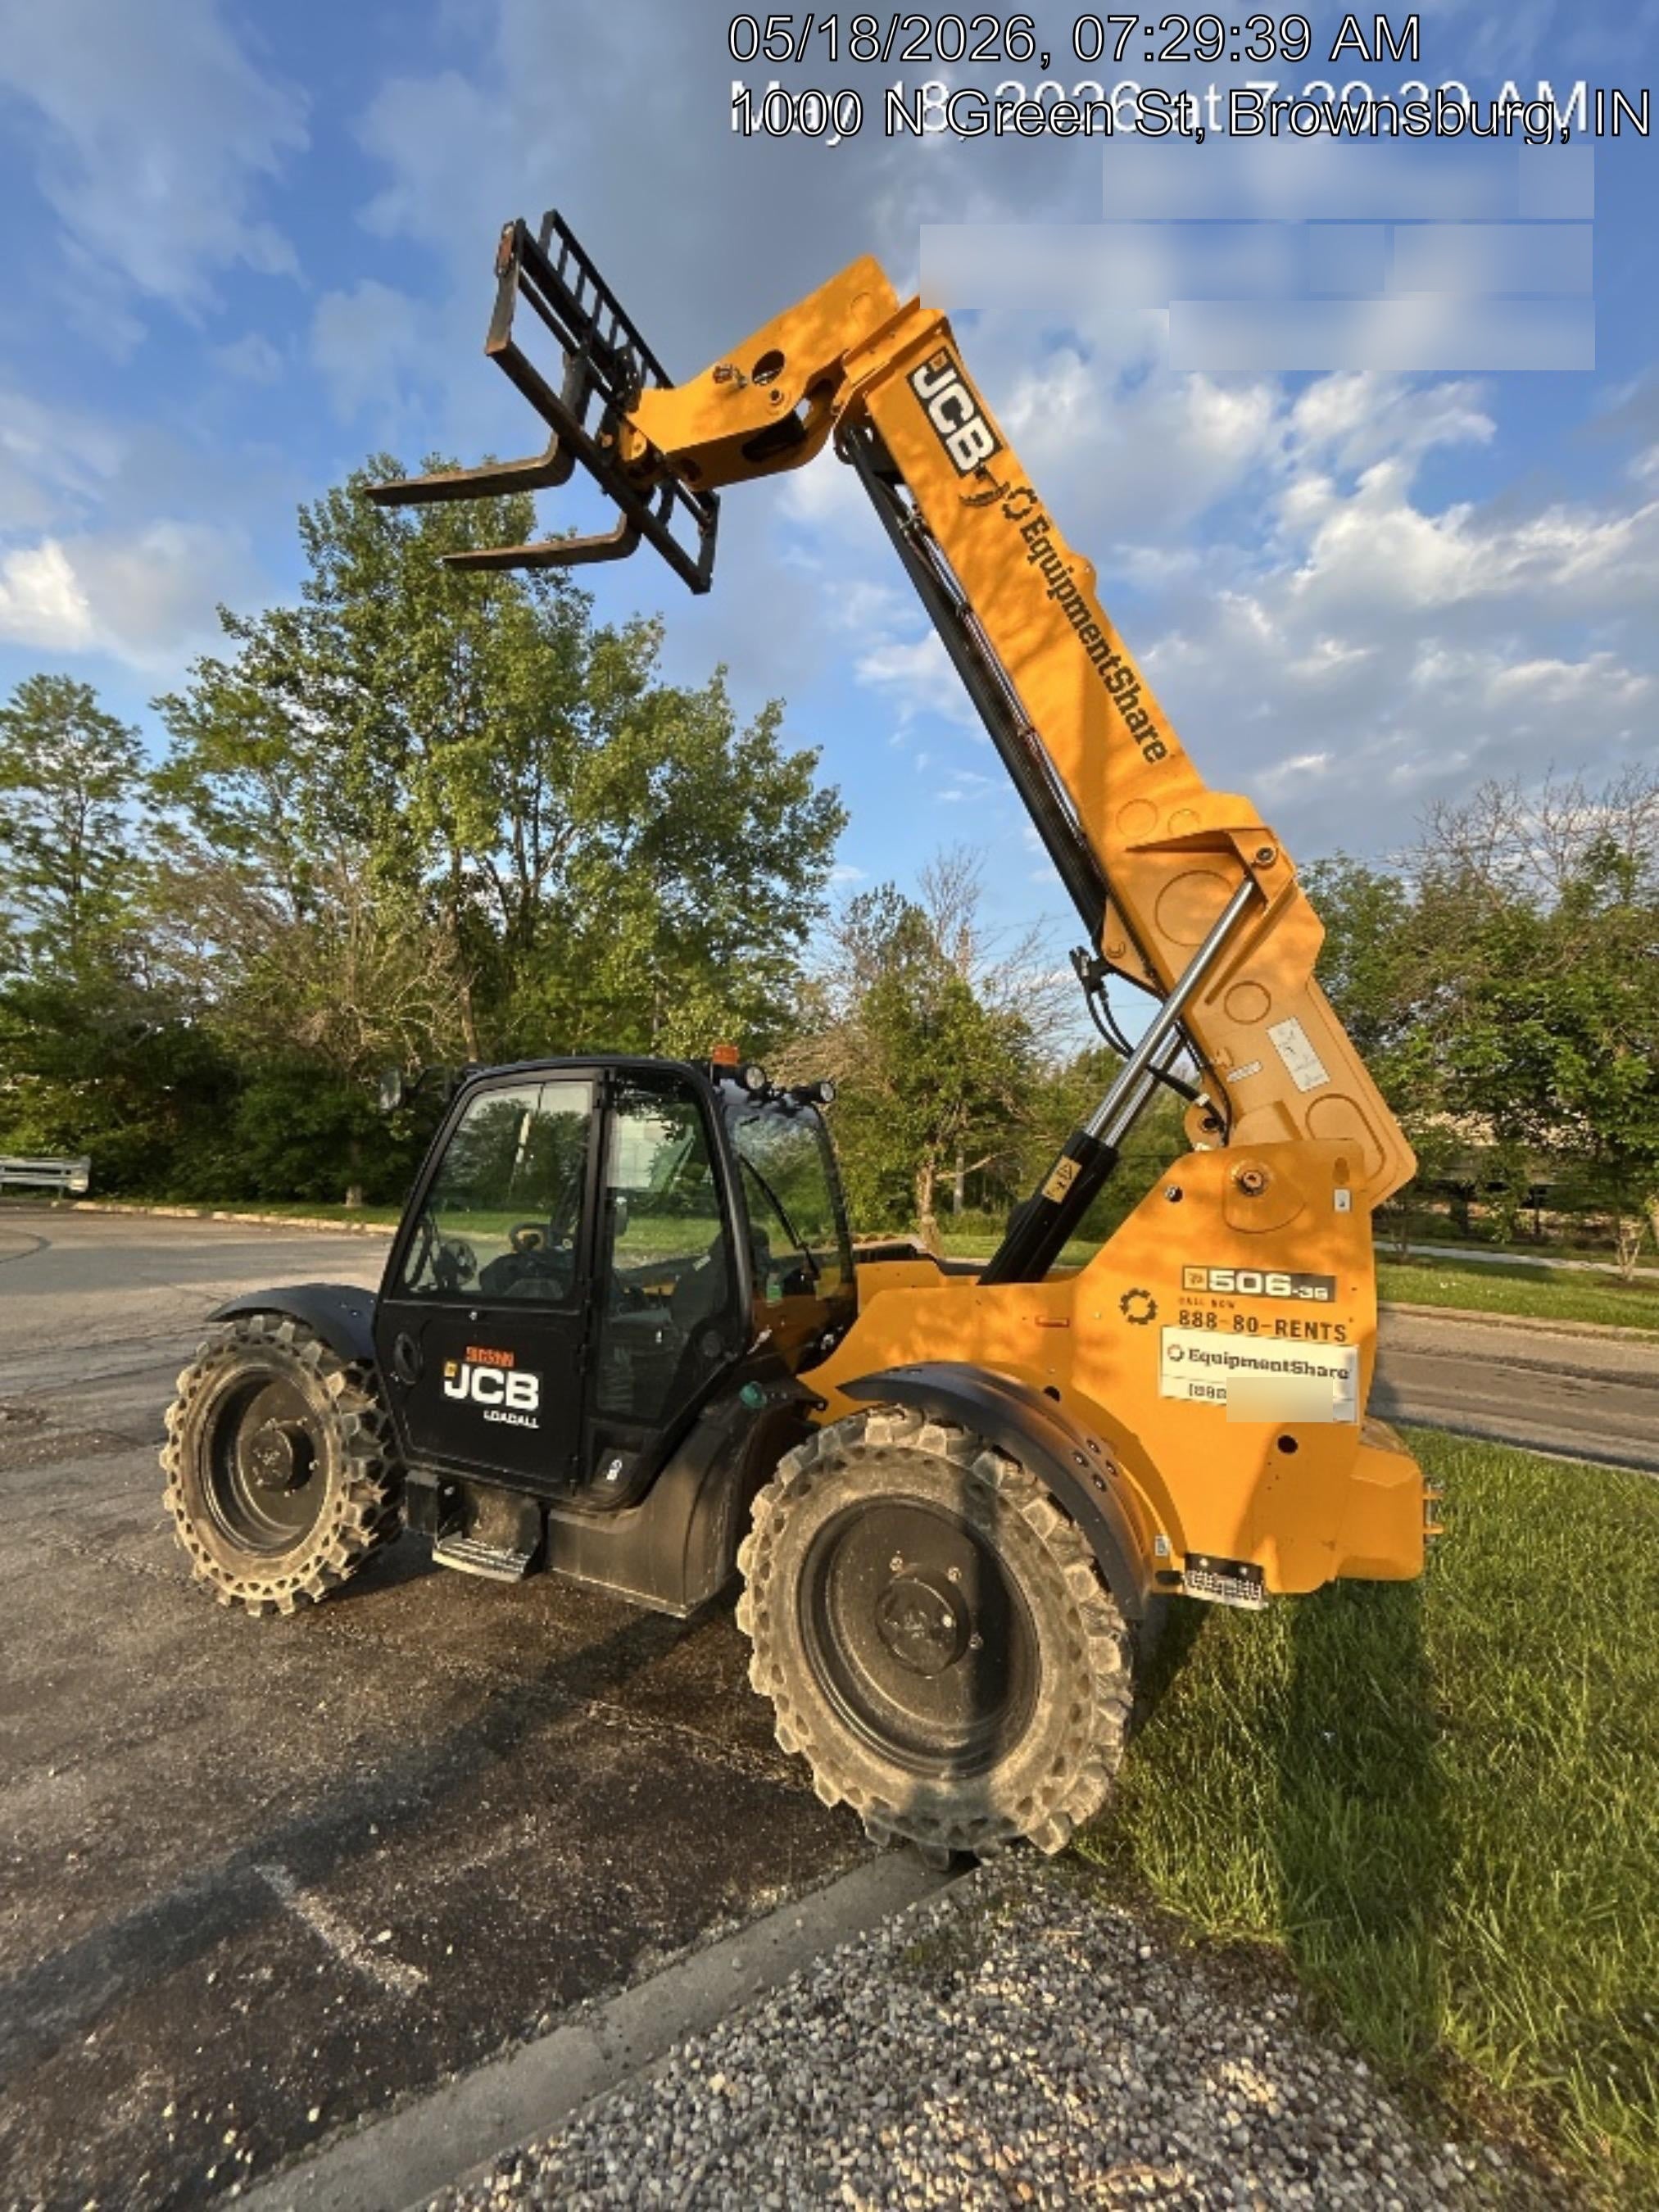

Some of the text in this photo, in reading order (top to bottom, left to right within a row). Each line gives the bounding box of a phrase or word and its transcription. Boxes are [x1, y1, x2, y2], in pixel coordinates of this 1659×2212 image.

[911, 365, 995, 473] JCB
[1019, 513, 1168, 764] EquipmentShare
[443, 1362, 539, 1411] JCB
[1189, 1349, 1349, 1380] EquipmentShare
